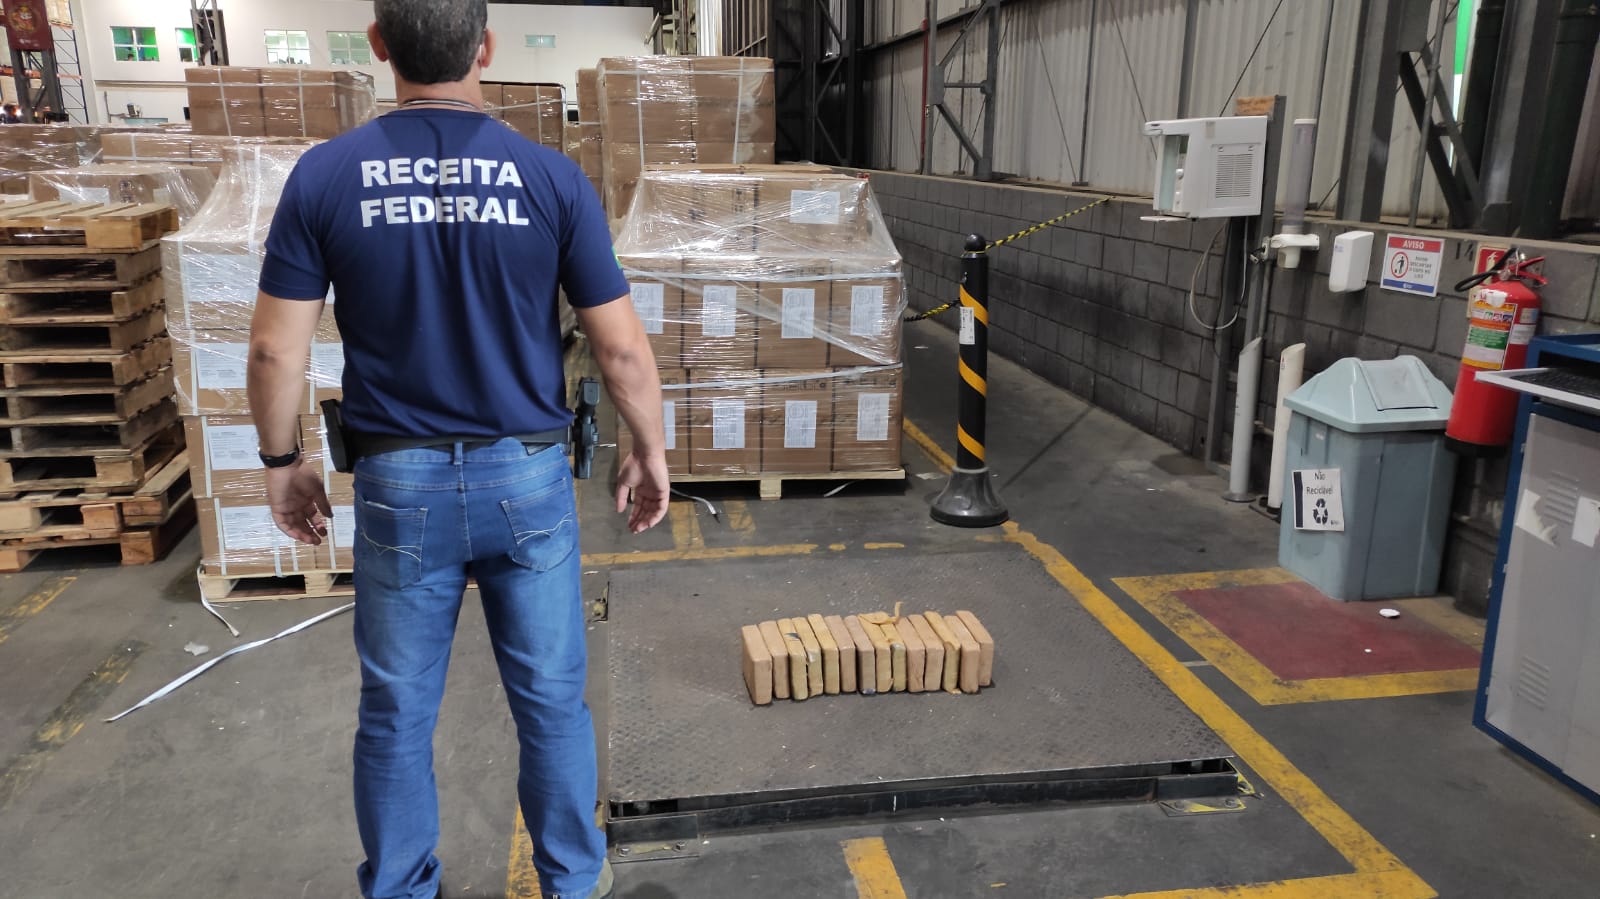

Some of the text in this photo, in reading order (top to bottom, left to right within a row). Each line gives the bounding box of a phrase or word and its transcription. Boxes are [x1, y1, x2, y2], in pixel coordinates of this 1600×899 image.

[361, 157, 523, 188] RECEITA
[360, 195, 530, 228] FEDERAL
[1402, 239, 1425, 250] AVISO
[1314, 471, 1325, 480] Não
